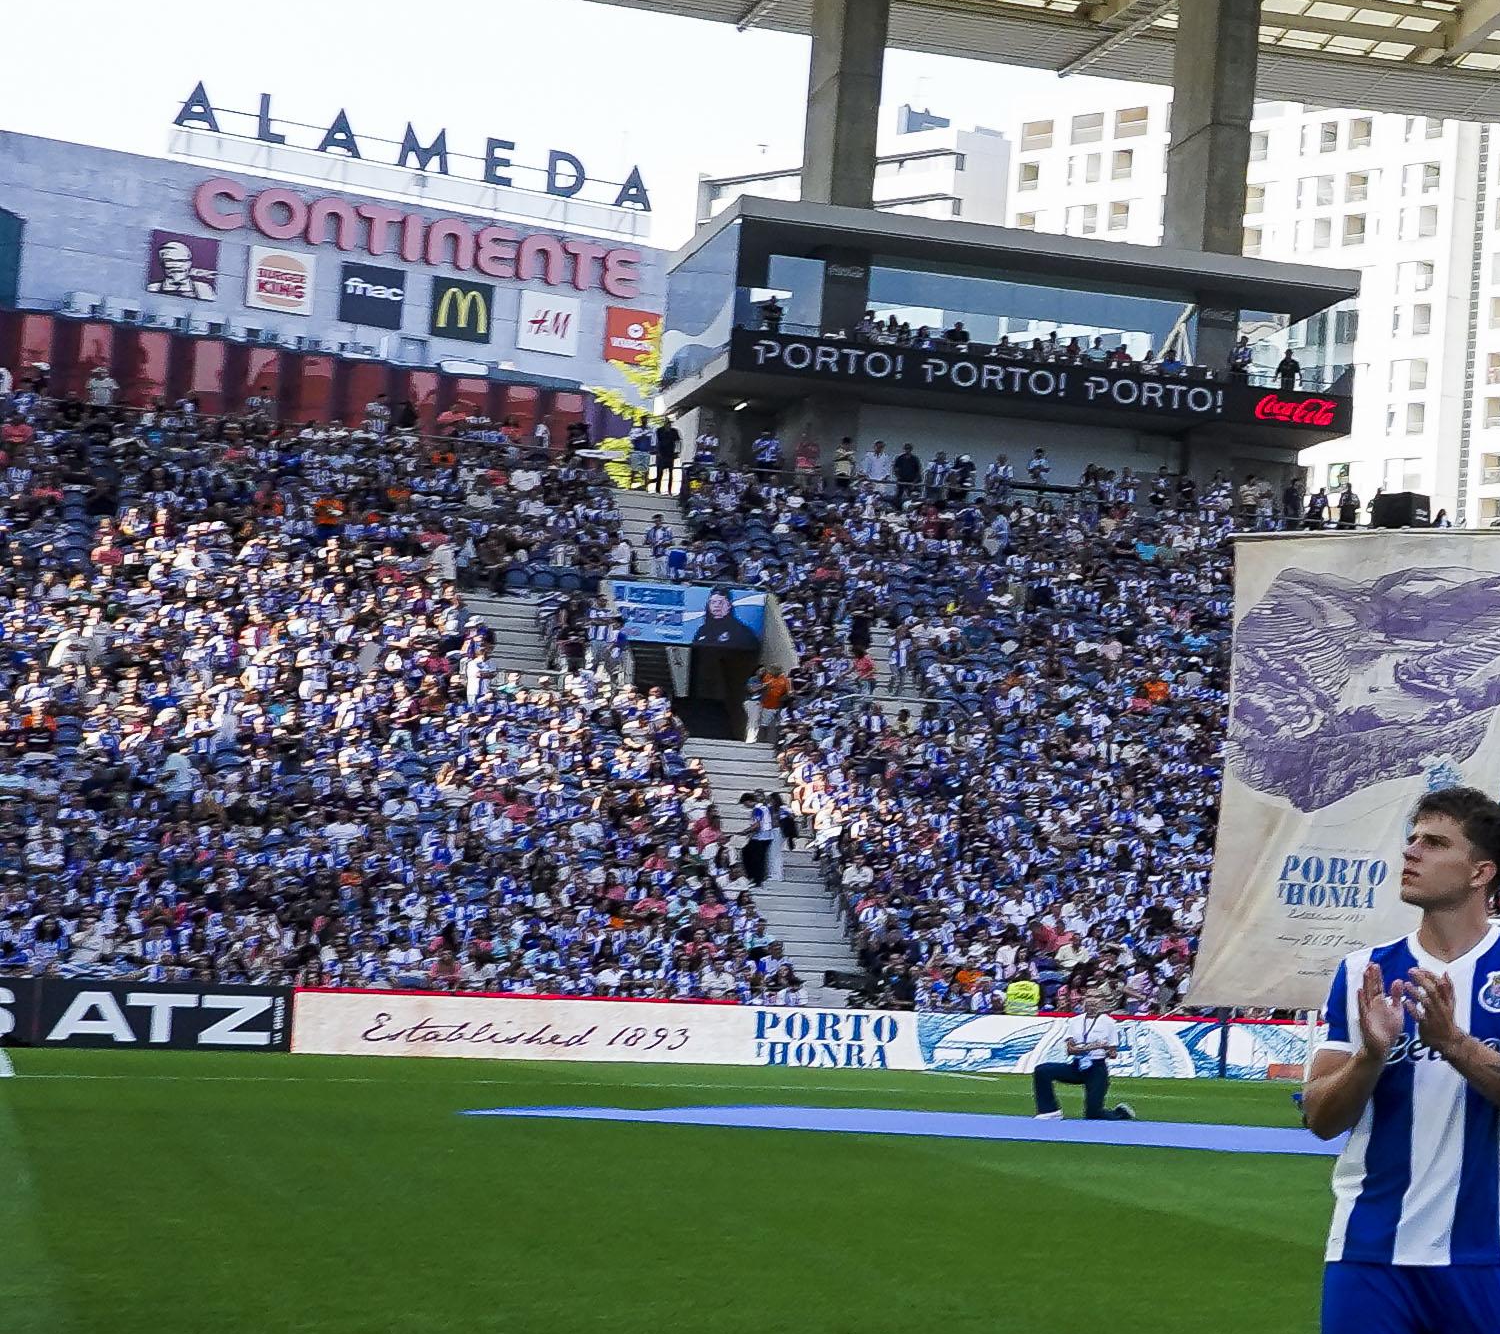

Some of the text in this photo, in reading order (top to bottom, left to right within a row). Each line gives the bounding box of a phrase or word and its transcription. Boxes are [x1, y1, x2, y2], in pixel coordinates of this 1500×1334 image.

[172, 80, 652, 212] ALAMEDA
[193, 176, 642, 300] CONTINENTE
[257, 280, 306, 299] KING
[343, 276, 405, 302] fnac
[753, 338, 1224, 414] PORTO! PORTO! PORTO!
[1276, 853, 1389, 887] PORTO
[1284, 882, 1377, 909] HONRA
[45, 991, 274, 1046] ATZ
[361, 1012, 692, 1052] Established 1893
[753, 1010, 900, 1044] PORTO
[767, 1042, 889, 1069] HONRA
